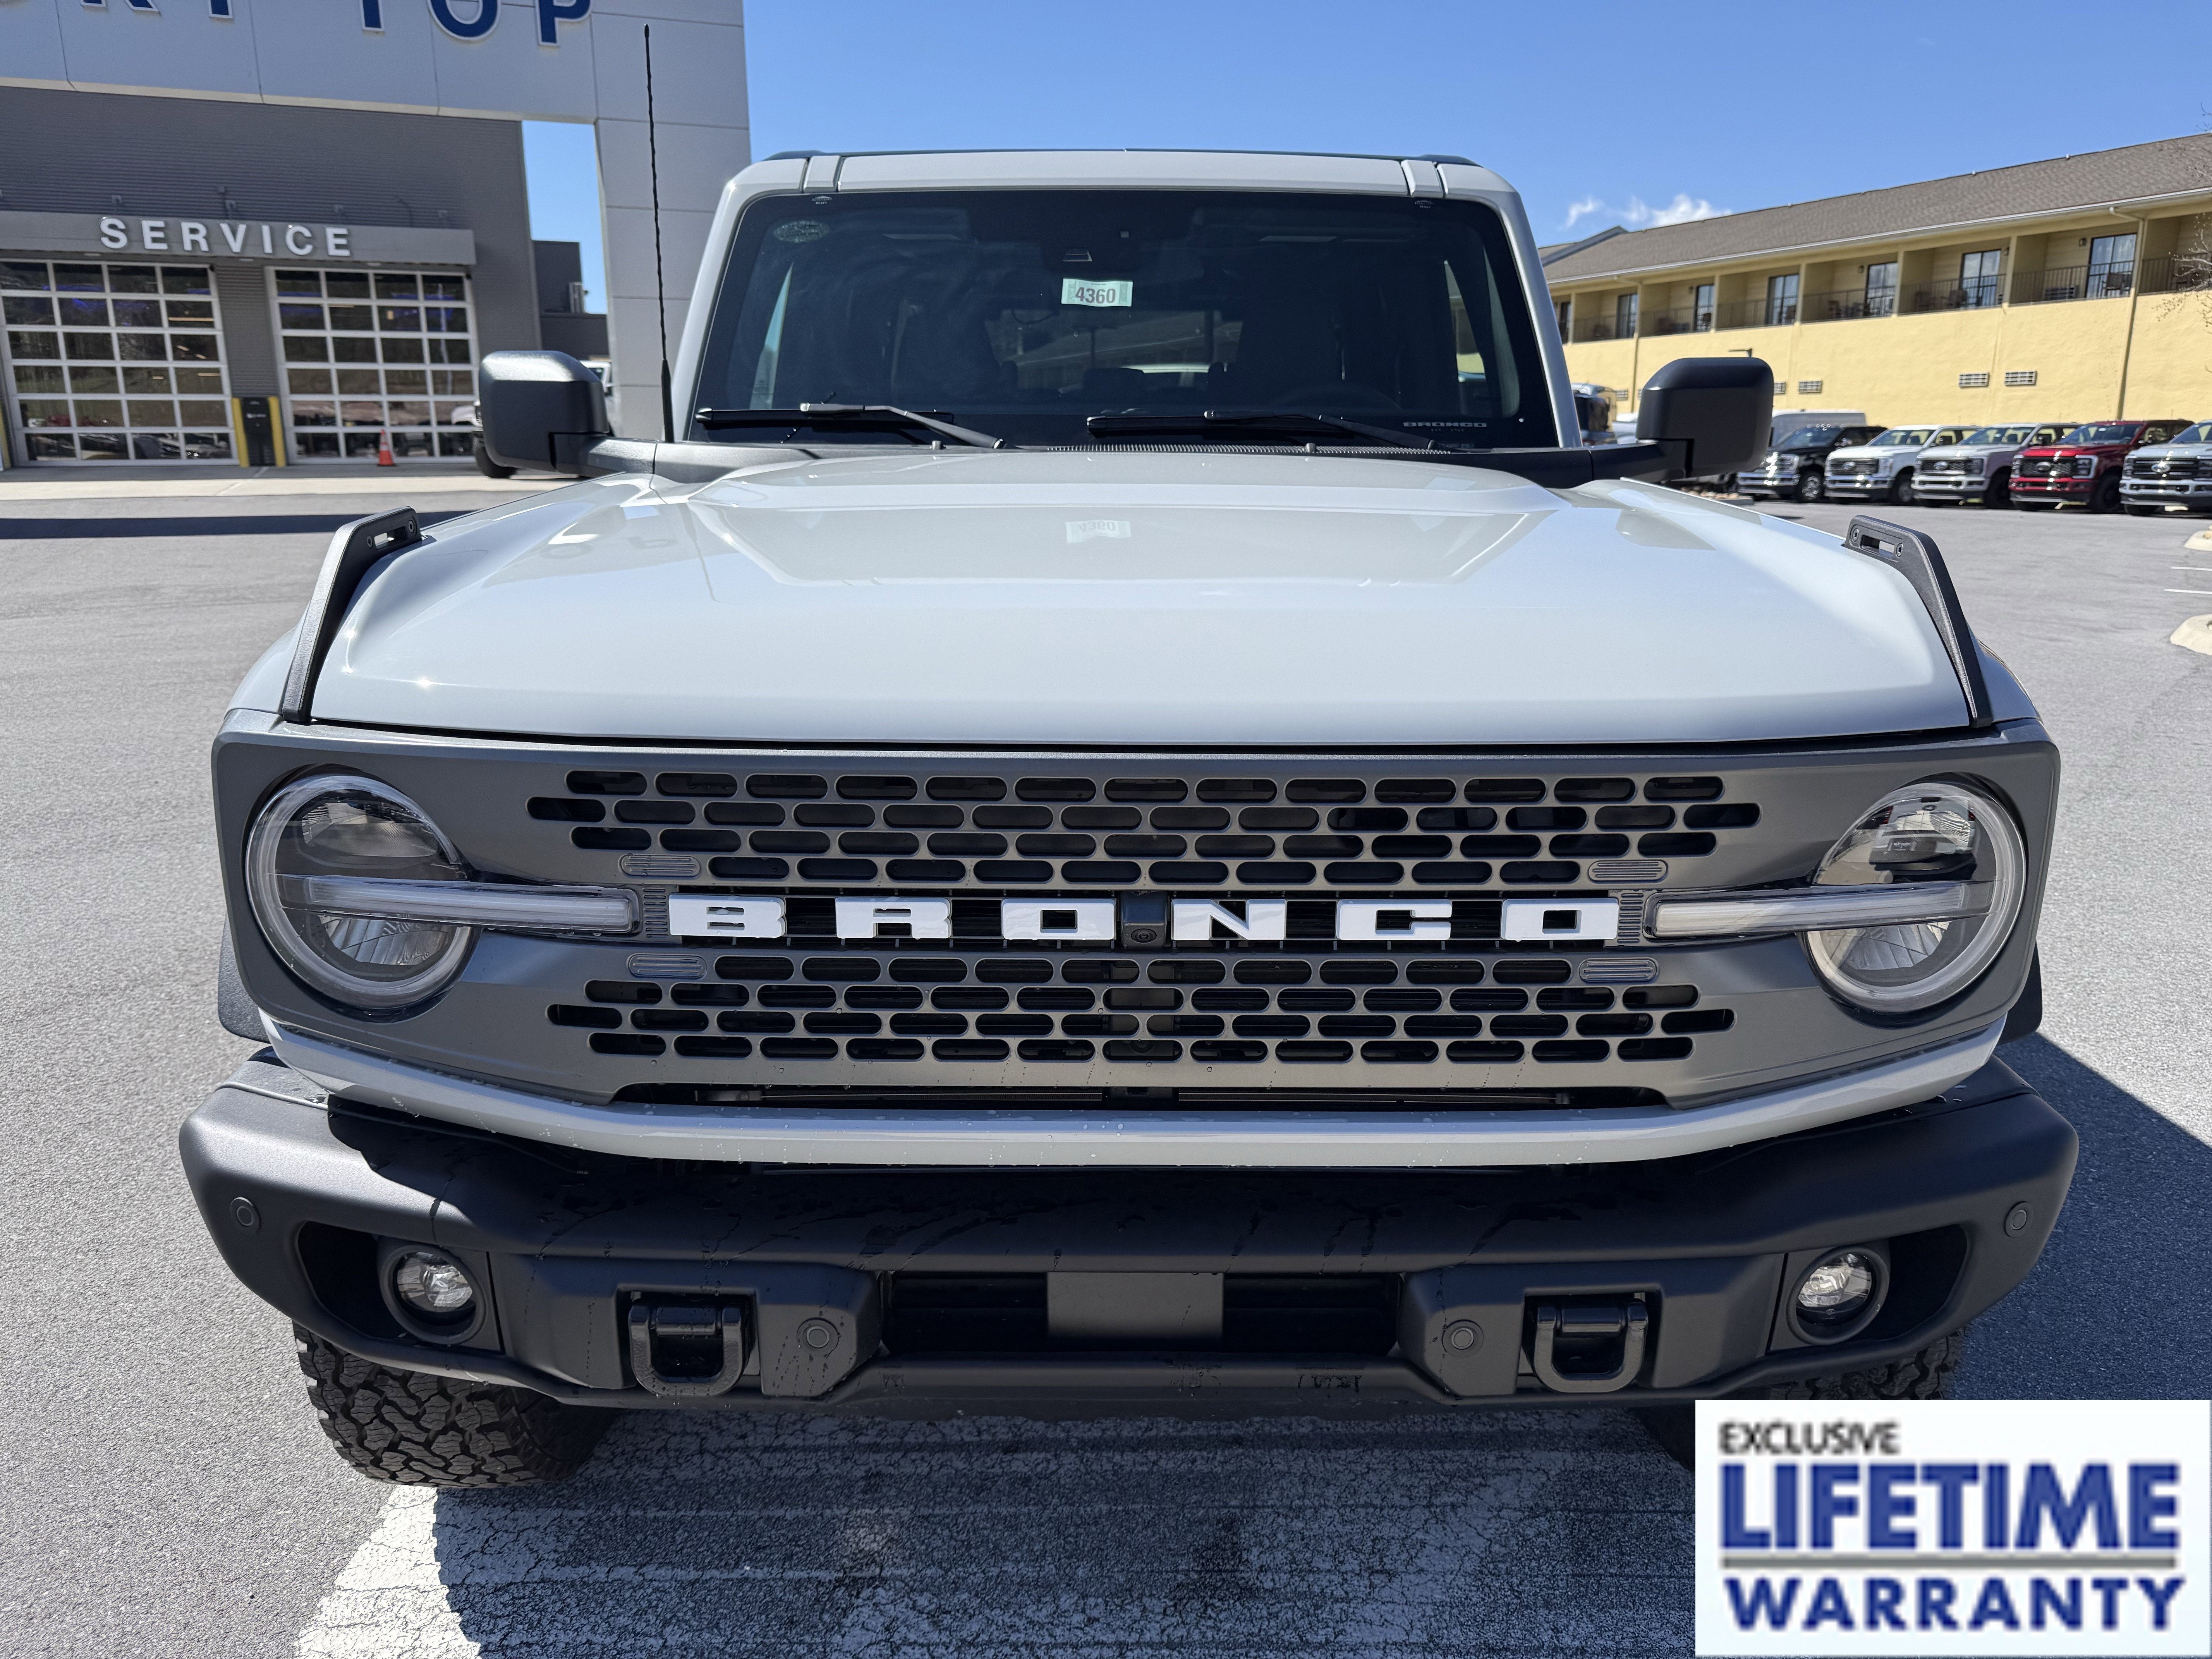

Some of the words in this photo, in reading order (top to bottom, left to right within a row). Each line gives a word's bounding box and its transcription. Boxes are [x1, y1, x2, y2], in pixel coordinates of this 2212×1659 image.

[100, 216, 350, 256] SERVICE
[1075, 287, 1116, 303] 4360
[668, 894, 1619, 941] BRONCO
